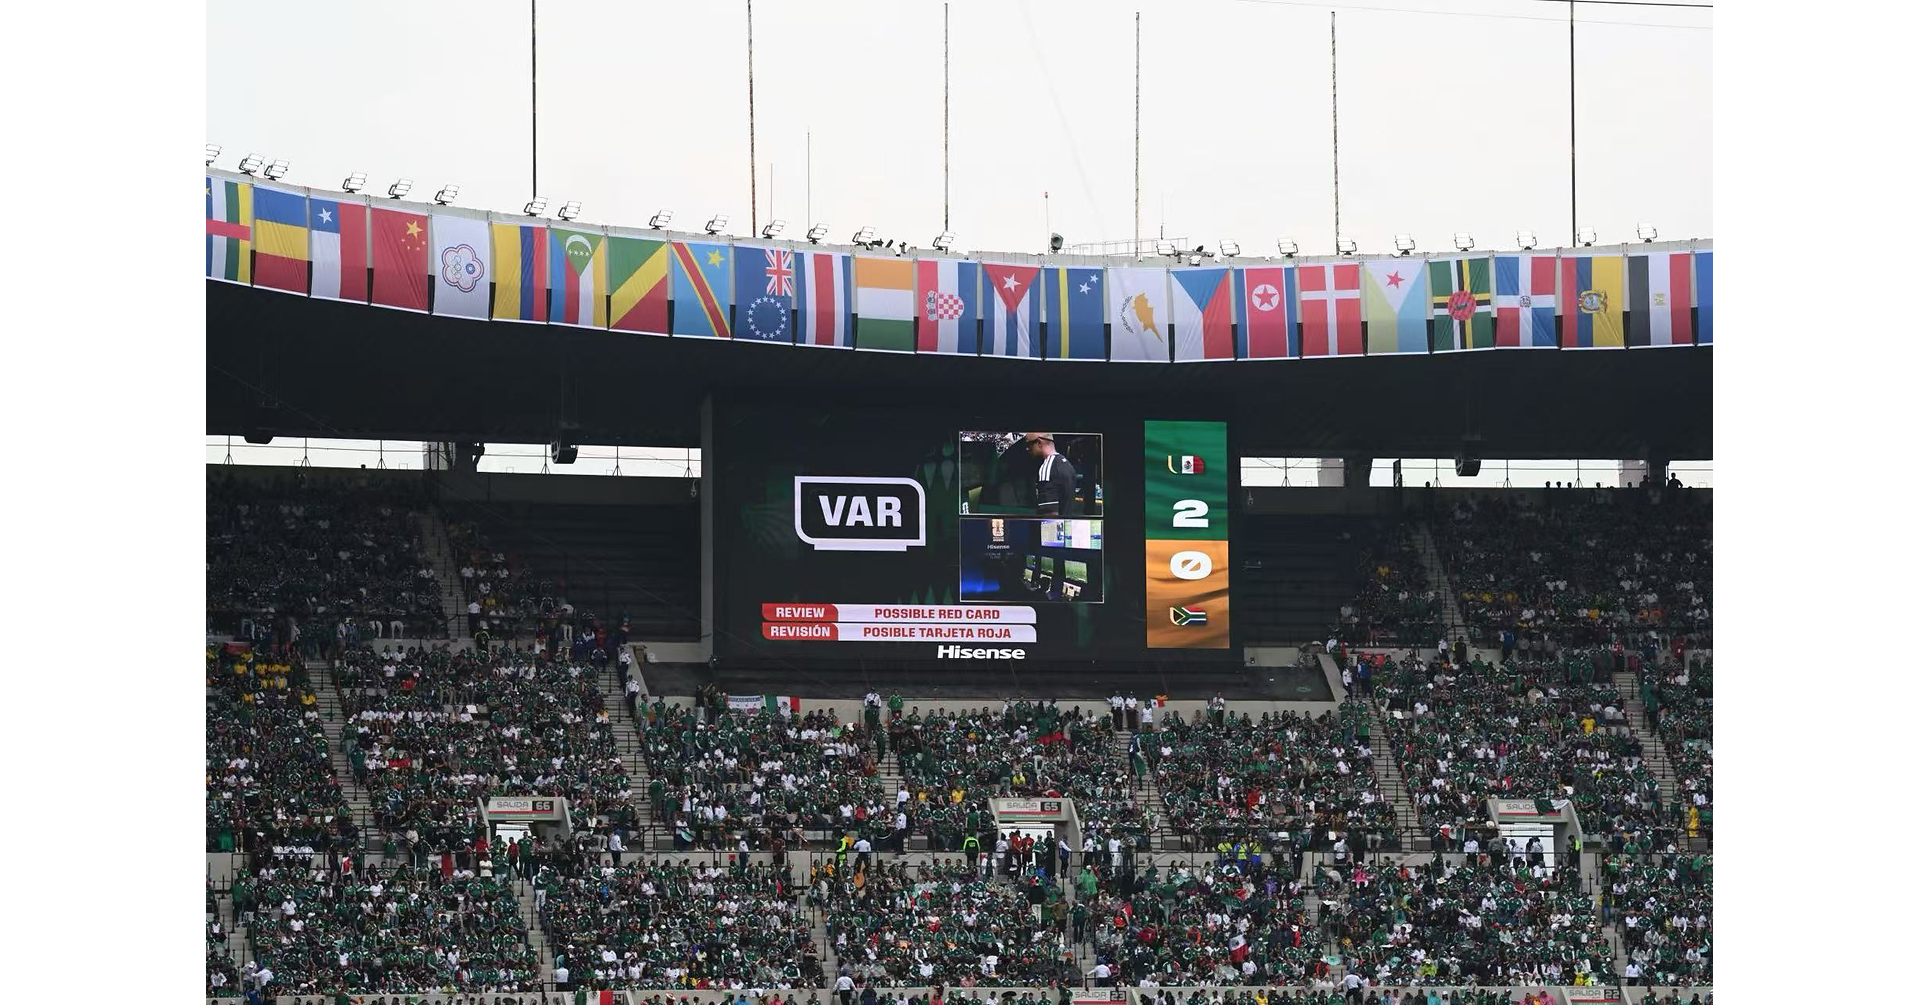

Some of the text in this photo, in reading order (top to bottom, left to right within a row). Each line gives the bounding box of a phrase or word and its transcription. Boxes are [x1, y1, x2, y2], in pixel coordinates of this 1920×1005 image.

[819, 495, 903, 527] VAR
[1172, 499, 1209, 528] 2
[1170, 551, 1213, 580] 0
[776, 607, 825, 619] REVIEW
[874, 607, 1000, 620] POSSIBLE RED CARD
[770, 624, 831, 638] REVISIÓN
[863, 626, 1012, 640] POSIBLE TARJETA ROJA
[938, 645, 1026, 660] Hisense
[497, 801, 551, 810] SALIDA 66
[1044, 802, 1059, 811] 65
[1605, 990, 1620, 999] 22
